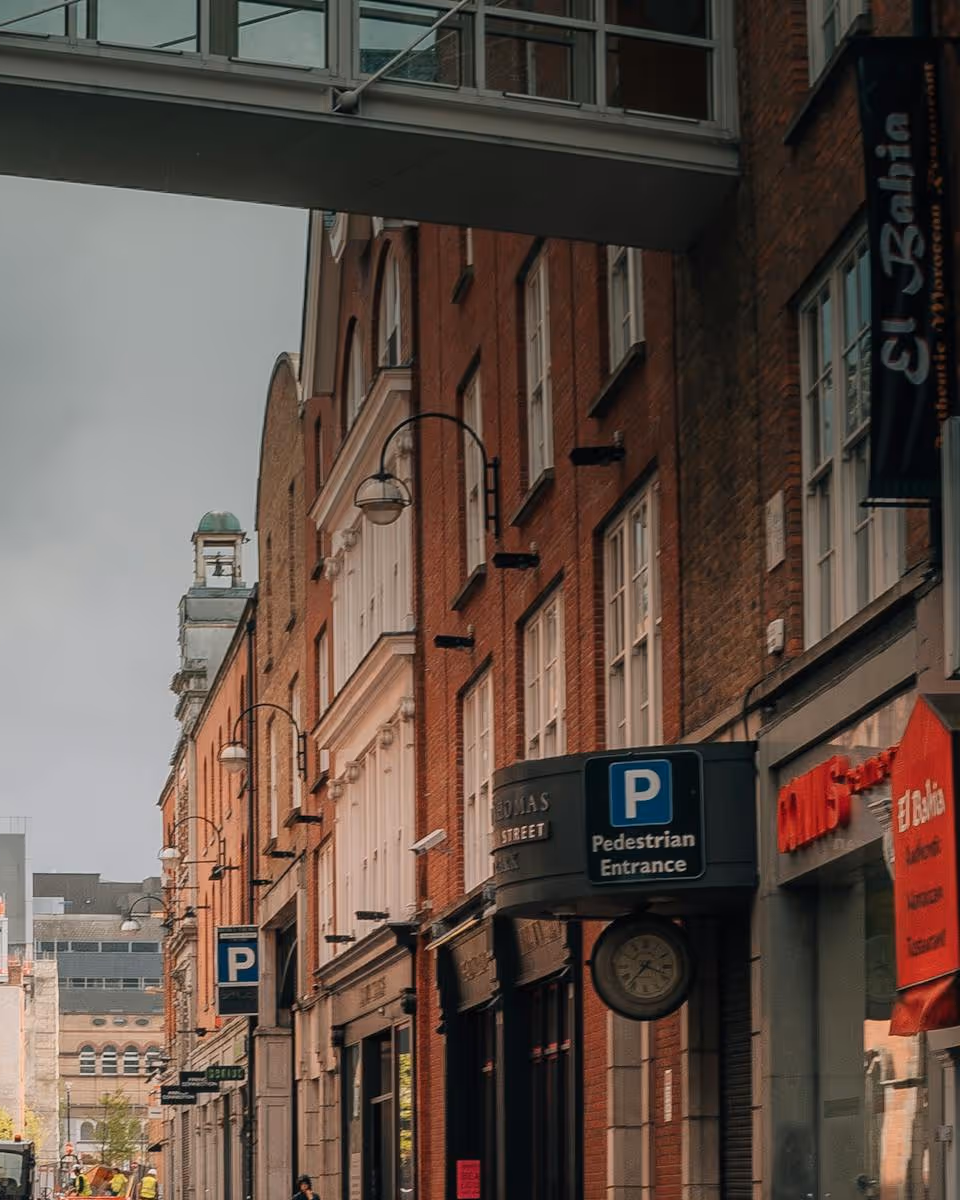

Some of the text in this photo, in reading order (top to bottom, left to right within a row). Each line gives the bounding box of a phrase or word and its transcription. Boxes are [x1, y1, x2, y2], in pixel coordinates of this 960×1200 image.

[875, 111, 930, 386] El Bahia
[495, 791, 550, 822] HOMAS
[624, 769, 661, 819] P
[897, 789, 911, 833] El
[912, 779, 946, 827] Bahia
[501, 822, 545, 844] STREET
[592, 831, 696, 852] Pedestrian
[600, 858, 687, 876] Entrance
[227, 947, 256, 981] P
